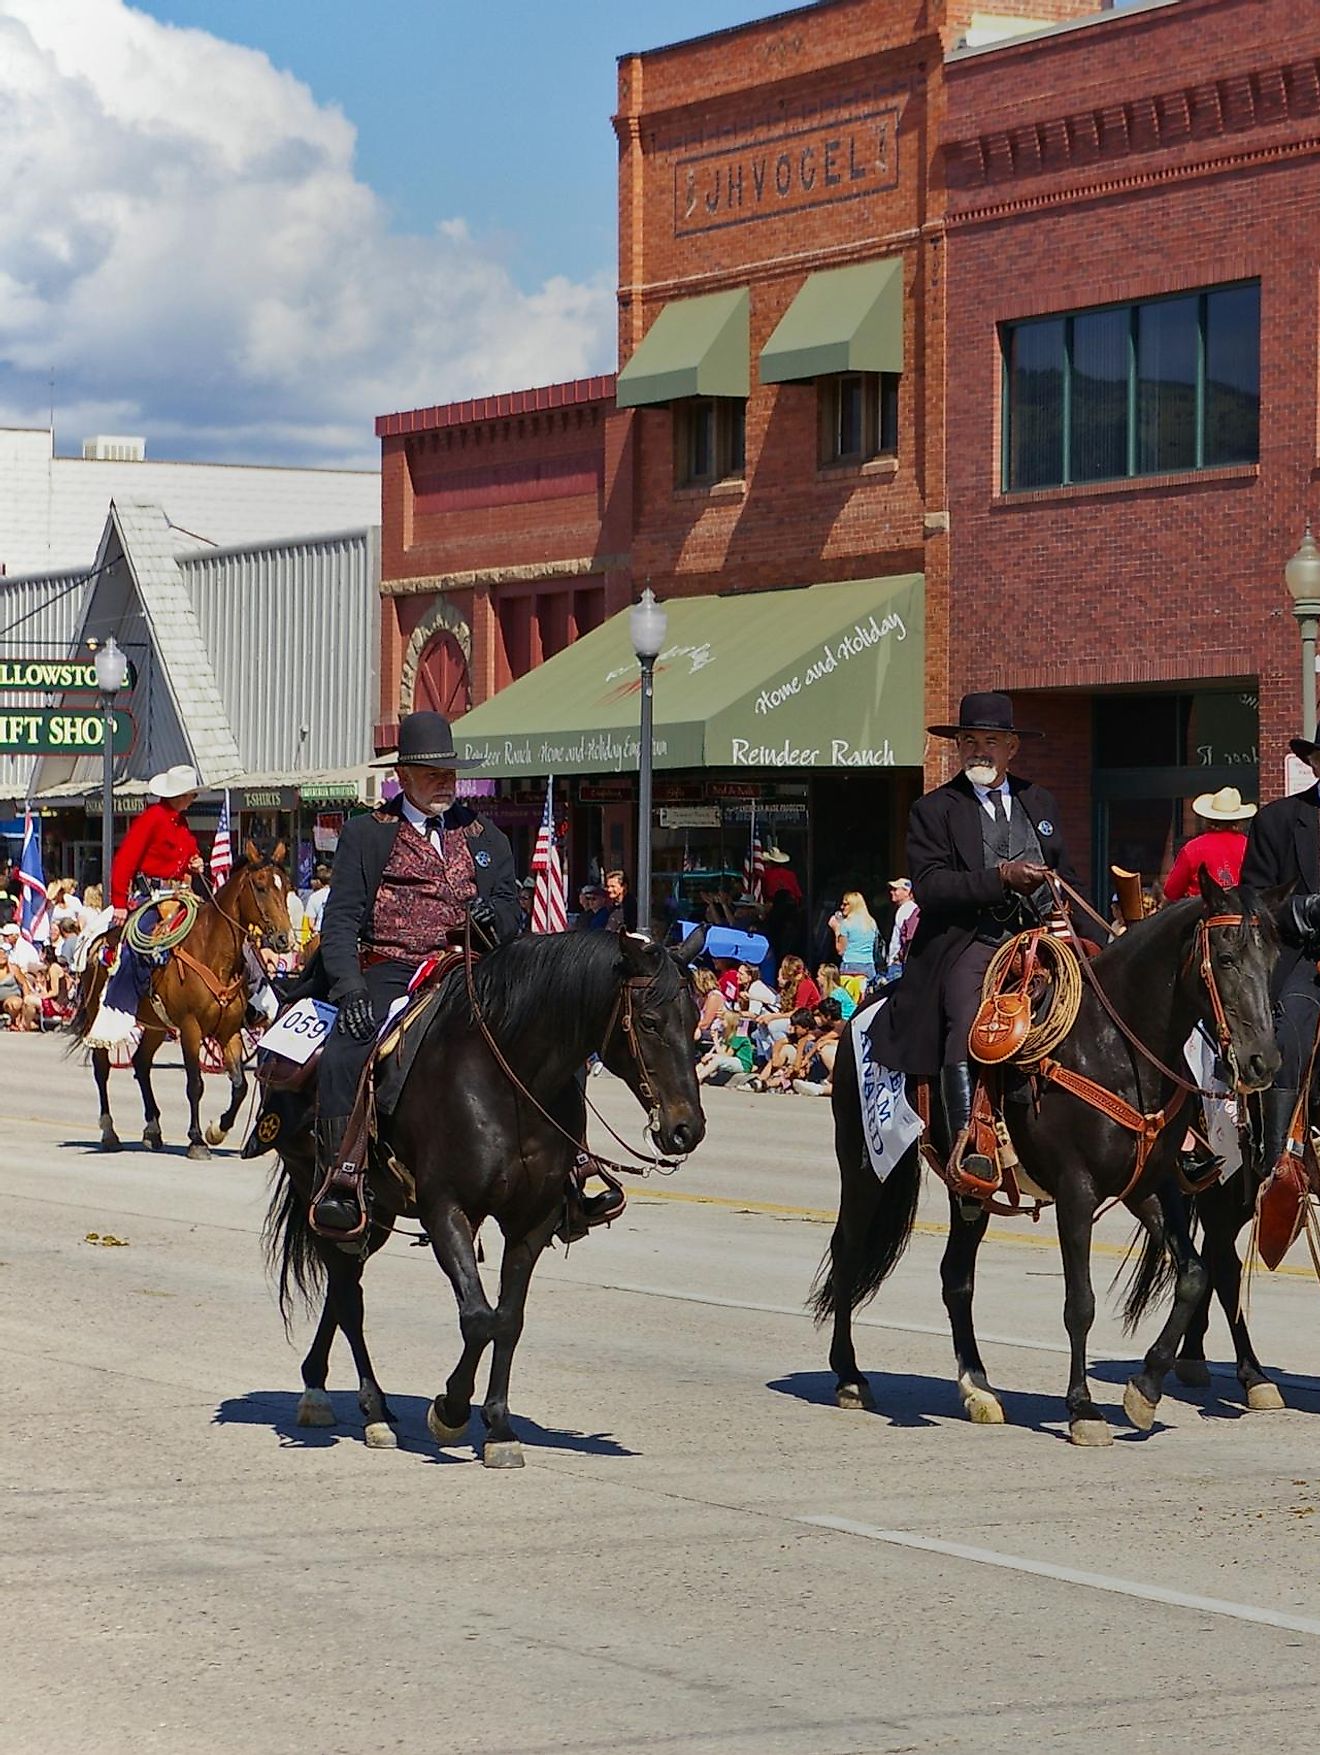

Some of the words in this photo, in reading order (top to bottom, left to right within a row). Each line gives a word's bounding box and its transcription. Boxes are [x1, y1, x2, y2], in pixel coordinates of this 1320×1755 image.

[755, 676, 802, 714] Home
[804, 646, 839, 686] and
[837, 611, 907, 660] Holiday
[732, 738, 819, 767] Reindeer
[831, 738, 895, 767] Ranch
[244, 792, 282, 807] T-SHIRTS
[283, 1011, 329, 1039] 059
